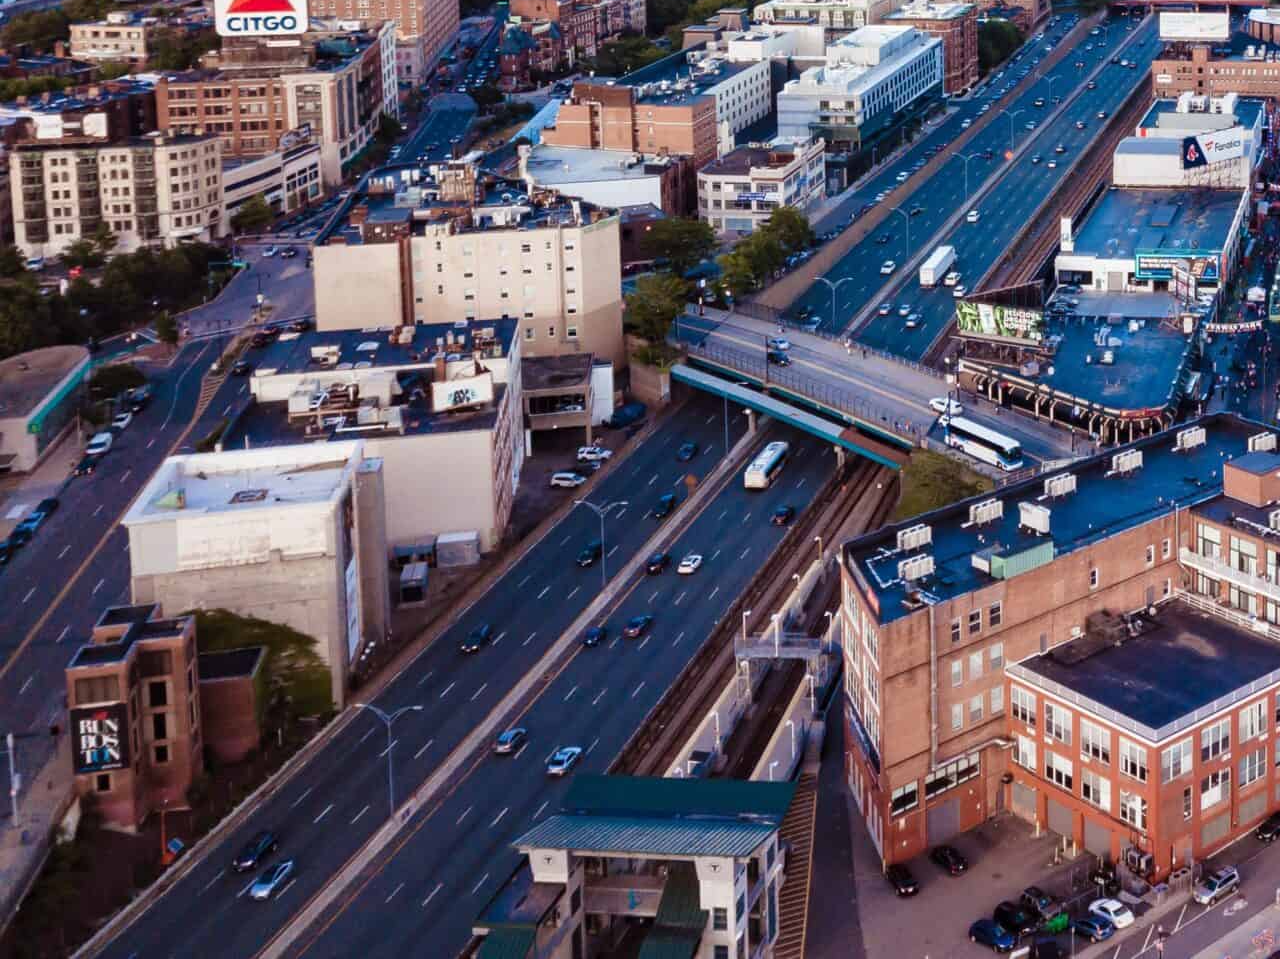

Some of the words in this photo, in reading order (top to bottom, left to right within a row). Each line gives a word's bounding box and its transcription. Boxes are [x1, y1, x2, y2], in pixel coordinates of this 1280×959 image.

[226, 16, 297, 32] CITGO
[79, 719, 119, 734] RUN
[80, 734, 120, 749] BOS
[80, 746, 121, 764] TON
